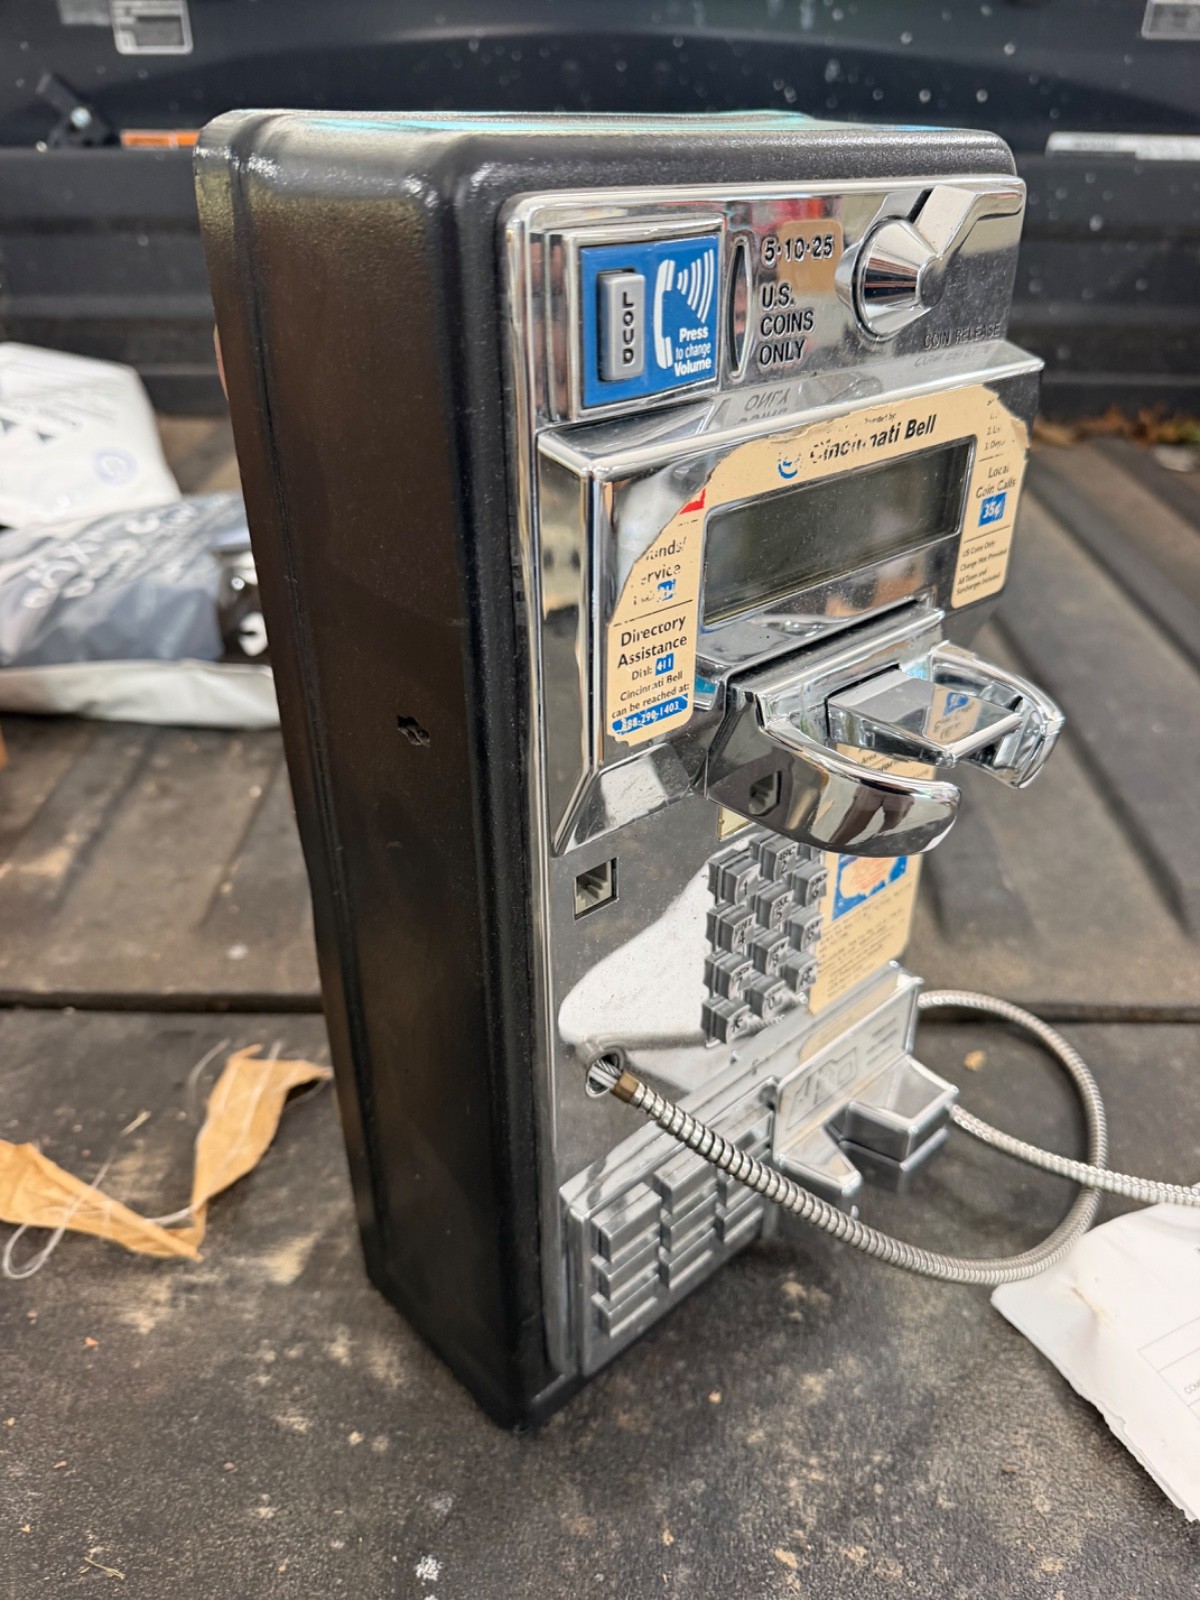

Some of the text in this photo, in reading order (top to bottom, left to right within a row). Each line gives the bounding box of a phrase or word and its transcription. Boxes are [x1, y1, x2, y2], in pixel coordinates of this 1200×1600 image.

[761, 284, 795, 309] U.S.
[622, 291, 635, 365] LOUD
[679, 326, 709, 343] Press
[760, 310, 814, 337] COINS
[675, 342, 711, 361] to change
[759, 339, 805, 366] ONLY
[674, 357, 712, 377] Volume
[904, 414, 938, 440] Bell
[620, 616, 687, 647] Directory
[616, 635, 688, 668] Assistance
[656, 657, 672, 672] 411
[666, 670, 683, 684] Bell
[611, 683, 690, 719] can be reached at:
